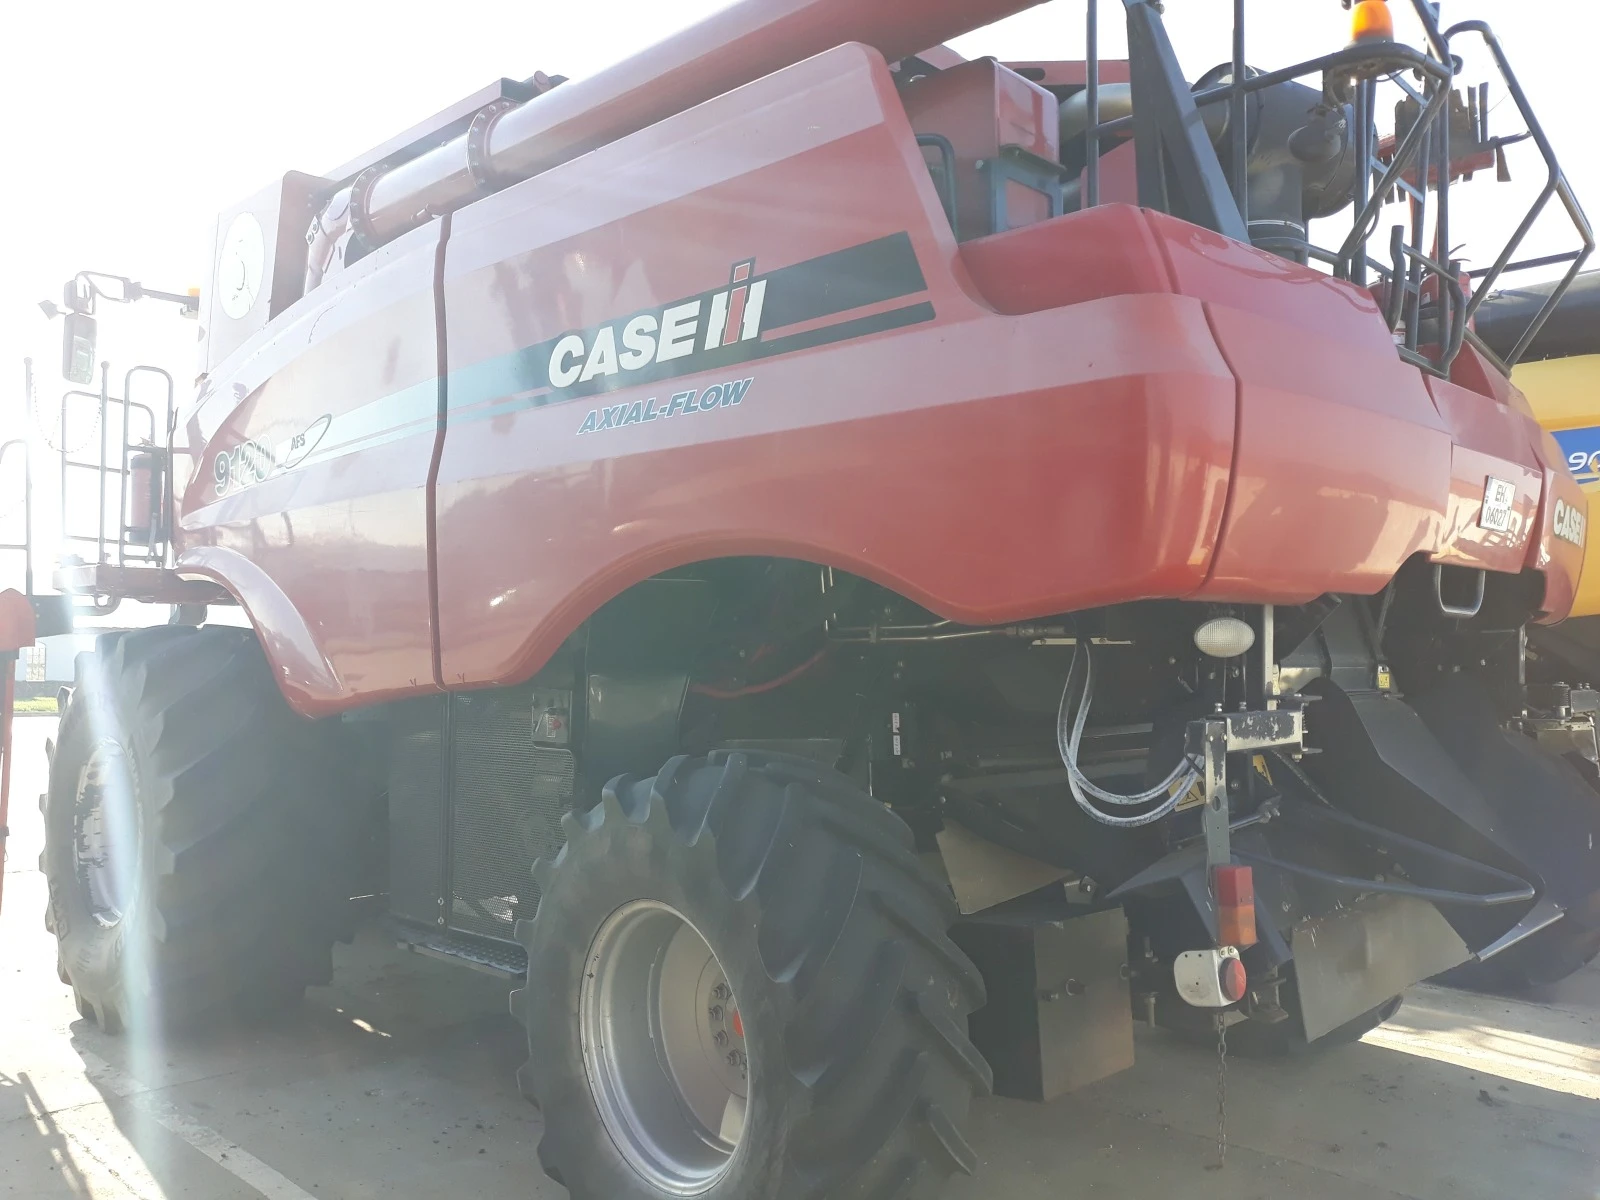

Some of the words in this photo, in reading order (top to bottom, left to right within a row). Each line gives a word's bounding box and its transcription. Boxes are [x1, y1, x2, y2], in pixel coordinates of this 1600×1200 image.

[548, 299, 701, 388] CASE
[576, 377, 755, 436] AXIAL-FLOW
[214, 434, 272, 497] 9120
[290, 433, 306, 450] AFS
